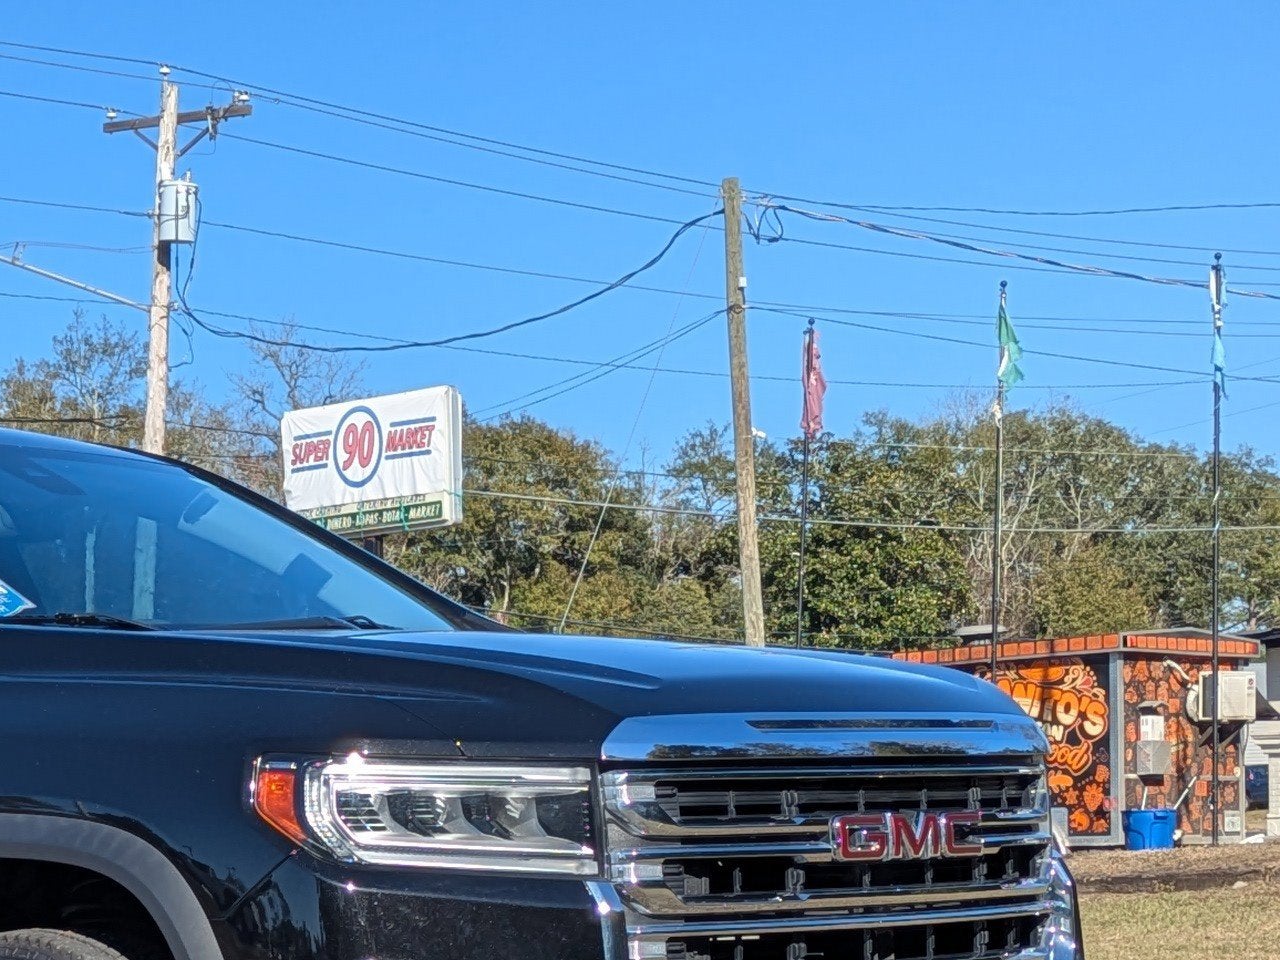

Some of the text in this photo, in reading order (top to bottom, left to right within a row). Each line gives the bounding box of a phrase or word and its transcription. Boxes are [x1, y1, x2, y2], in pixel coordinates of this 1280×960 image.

[291, 420, 435, 472] SUPER 90 MARKET
[829, 809, 984, 862] GMC
